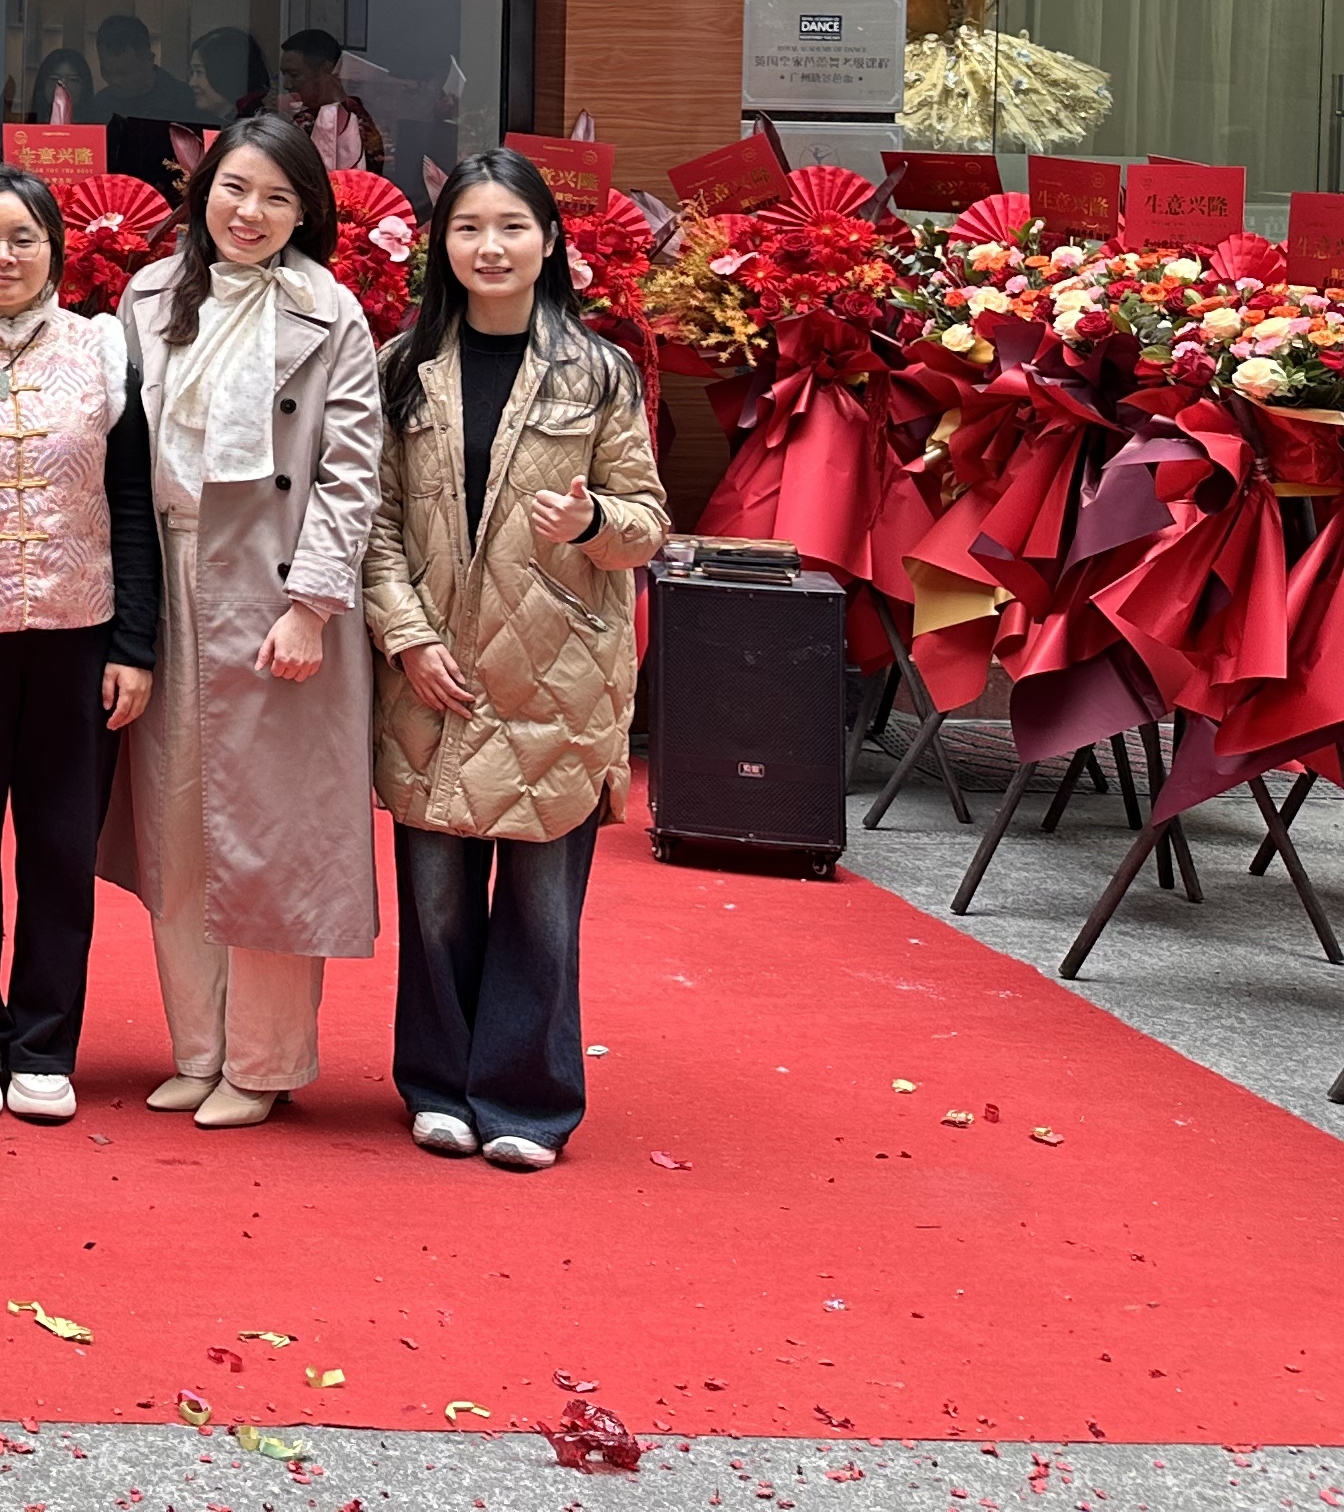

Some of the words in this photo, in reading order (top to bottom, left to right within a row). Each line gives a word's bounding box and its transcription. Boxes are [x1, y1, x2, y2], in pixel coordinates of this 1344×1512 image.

[801, 21, 840, 32] DANCE
[18, 145, 94, 167] 生意兴隆
[1145, 194, 1229, 217] 生意兴隆
